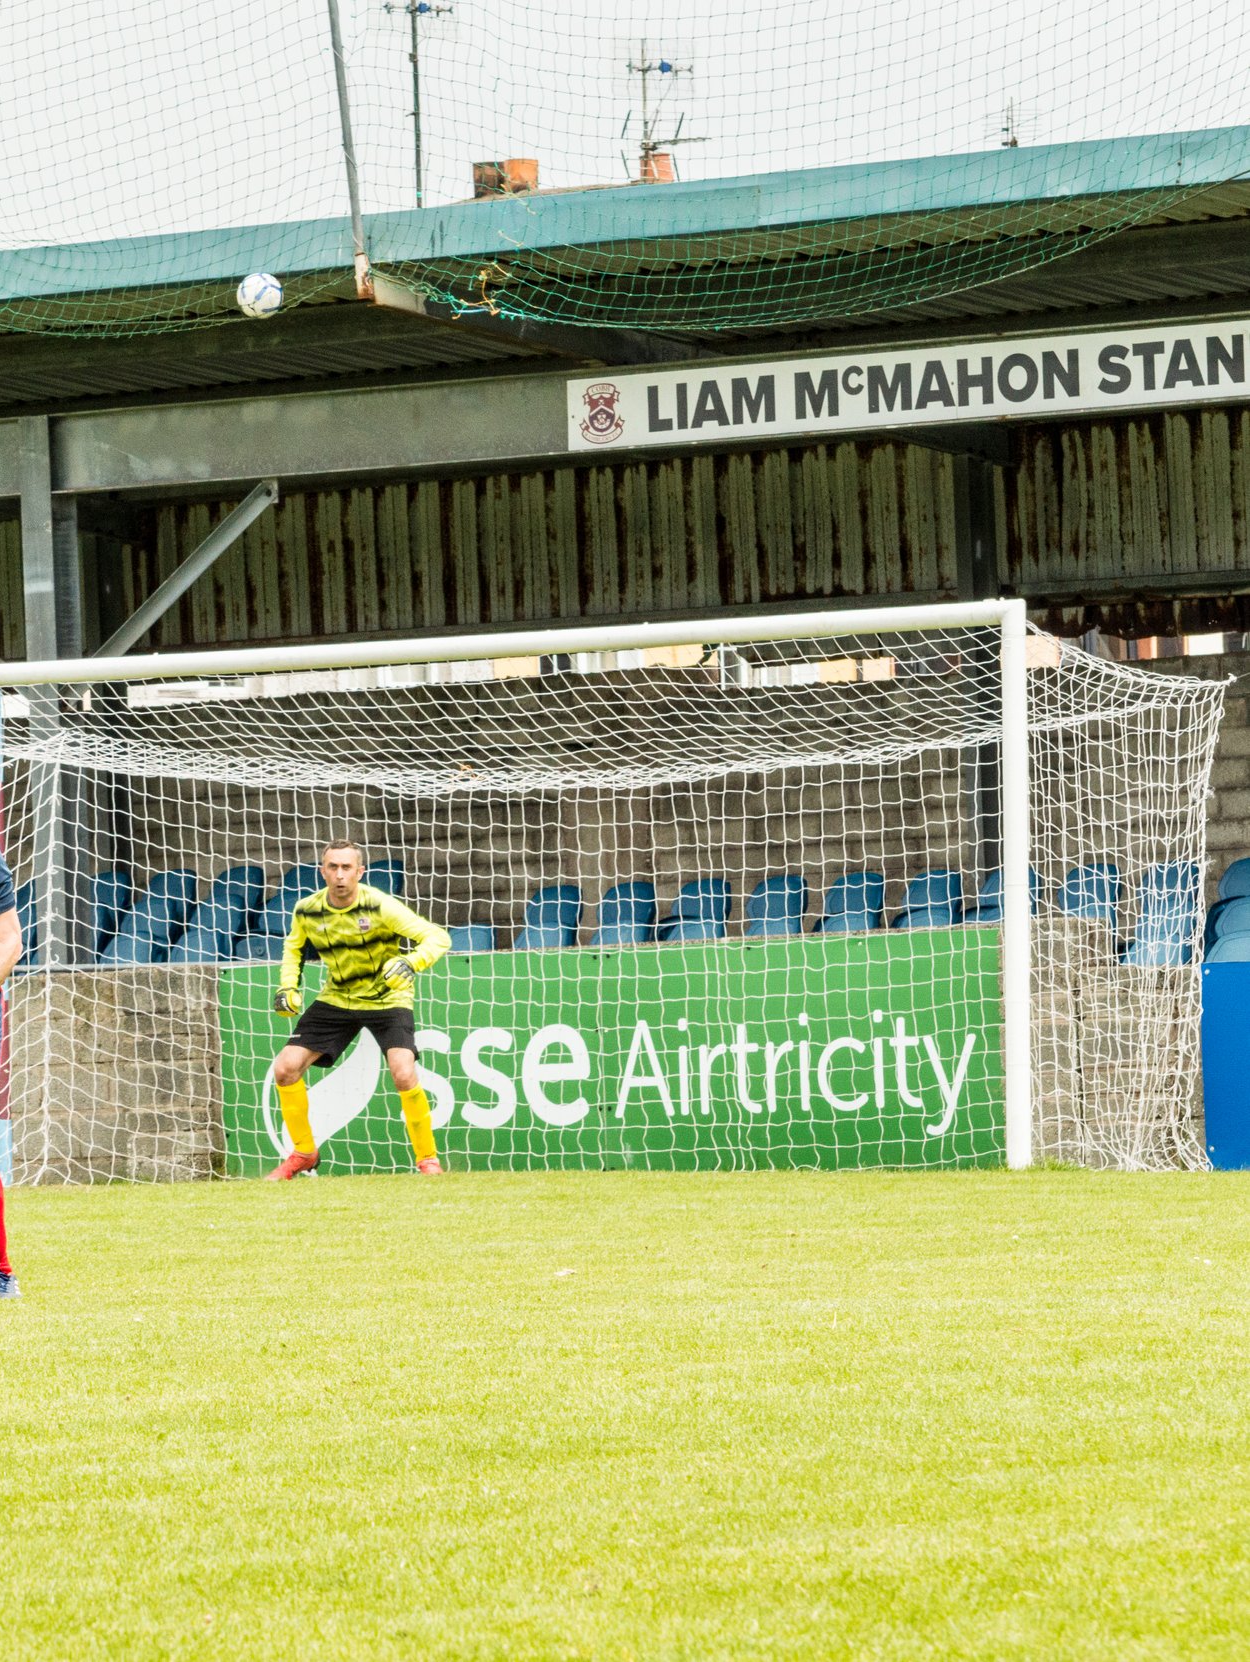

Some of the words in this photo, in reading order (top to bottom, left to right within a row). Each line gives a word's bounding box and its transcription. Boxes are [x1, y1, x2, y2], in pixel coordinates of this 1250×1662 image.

[646, 374, 777, 433] LIAM
[400, 1023, 592, 1130] sse
[614, 1008, 977, 1137] Airtricity
